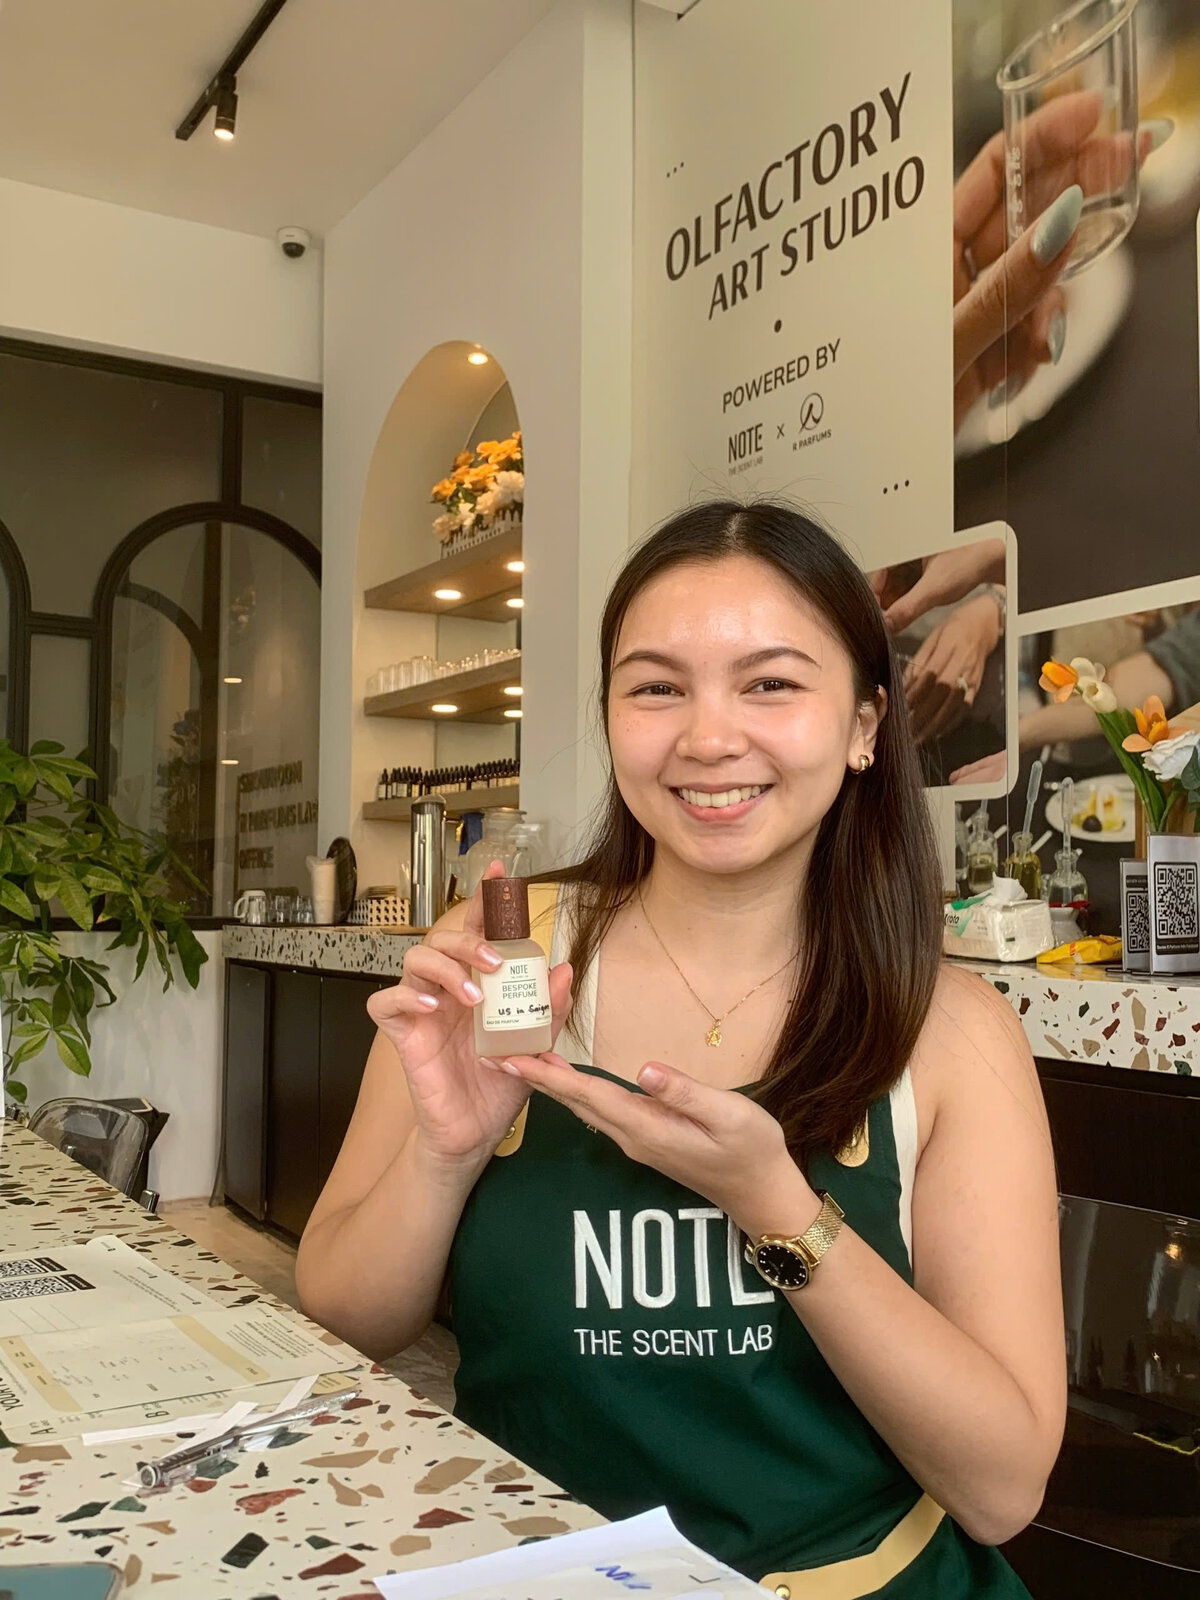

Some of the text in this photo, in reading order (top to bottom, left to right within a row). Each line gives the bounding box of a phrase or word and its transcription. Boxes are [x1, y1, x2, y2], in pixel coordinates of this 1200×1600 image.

[666, 71, 911, 281] OLFACTORY
[709, 156, 925, 320] ART STUDIO
[723, 338, 840, 414] POWERED BY
[728, 422, 763, 463] NOTE
[792, 429, 832, 452] R PARFUMS
[510, 964, 528, 975] NOTE
[502, 983, 537, 993] BESPOKE
[502, 990, 537, 1000] PERFUME
[573, 1208, 775, 1309] NOTE
[574, 1324, 773, 1356] THE SCENT LAB
